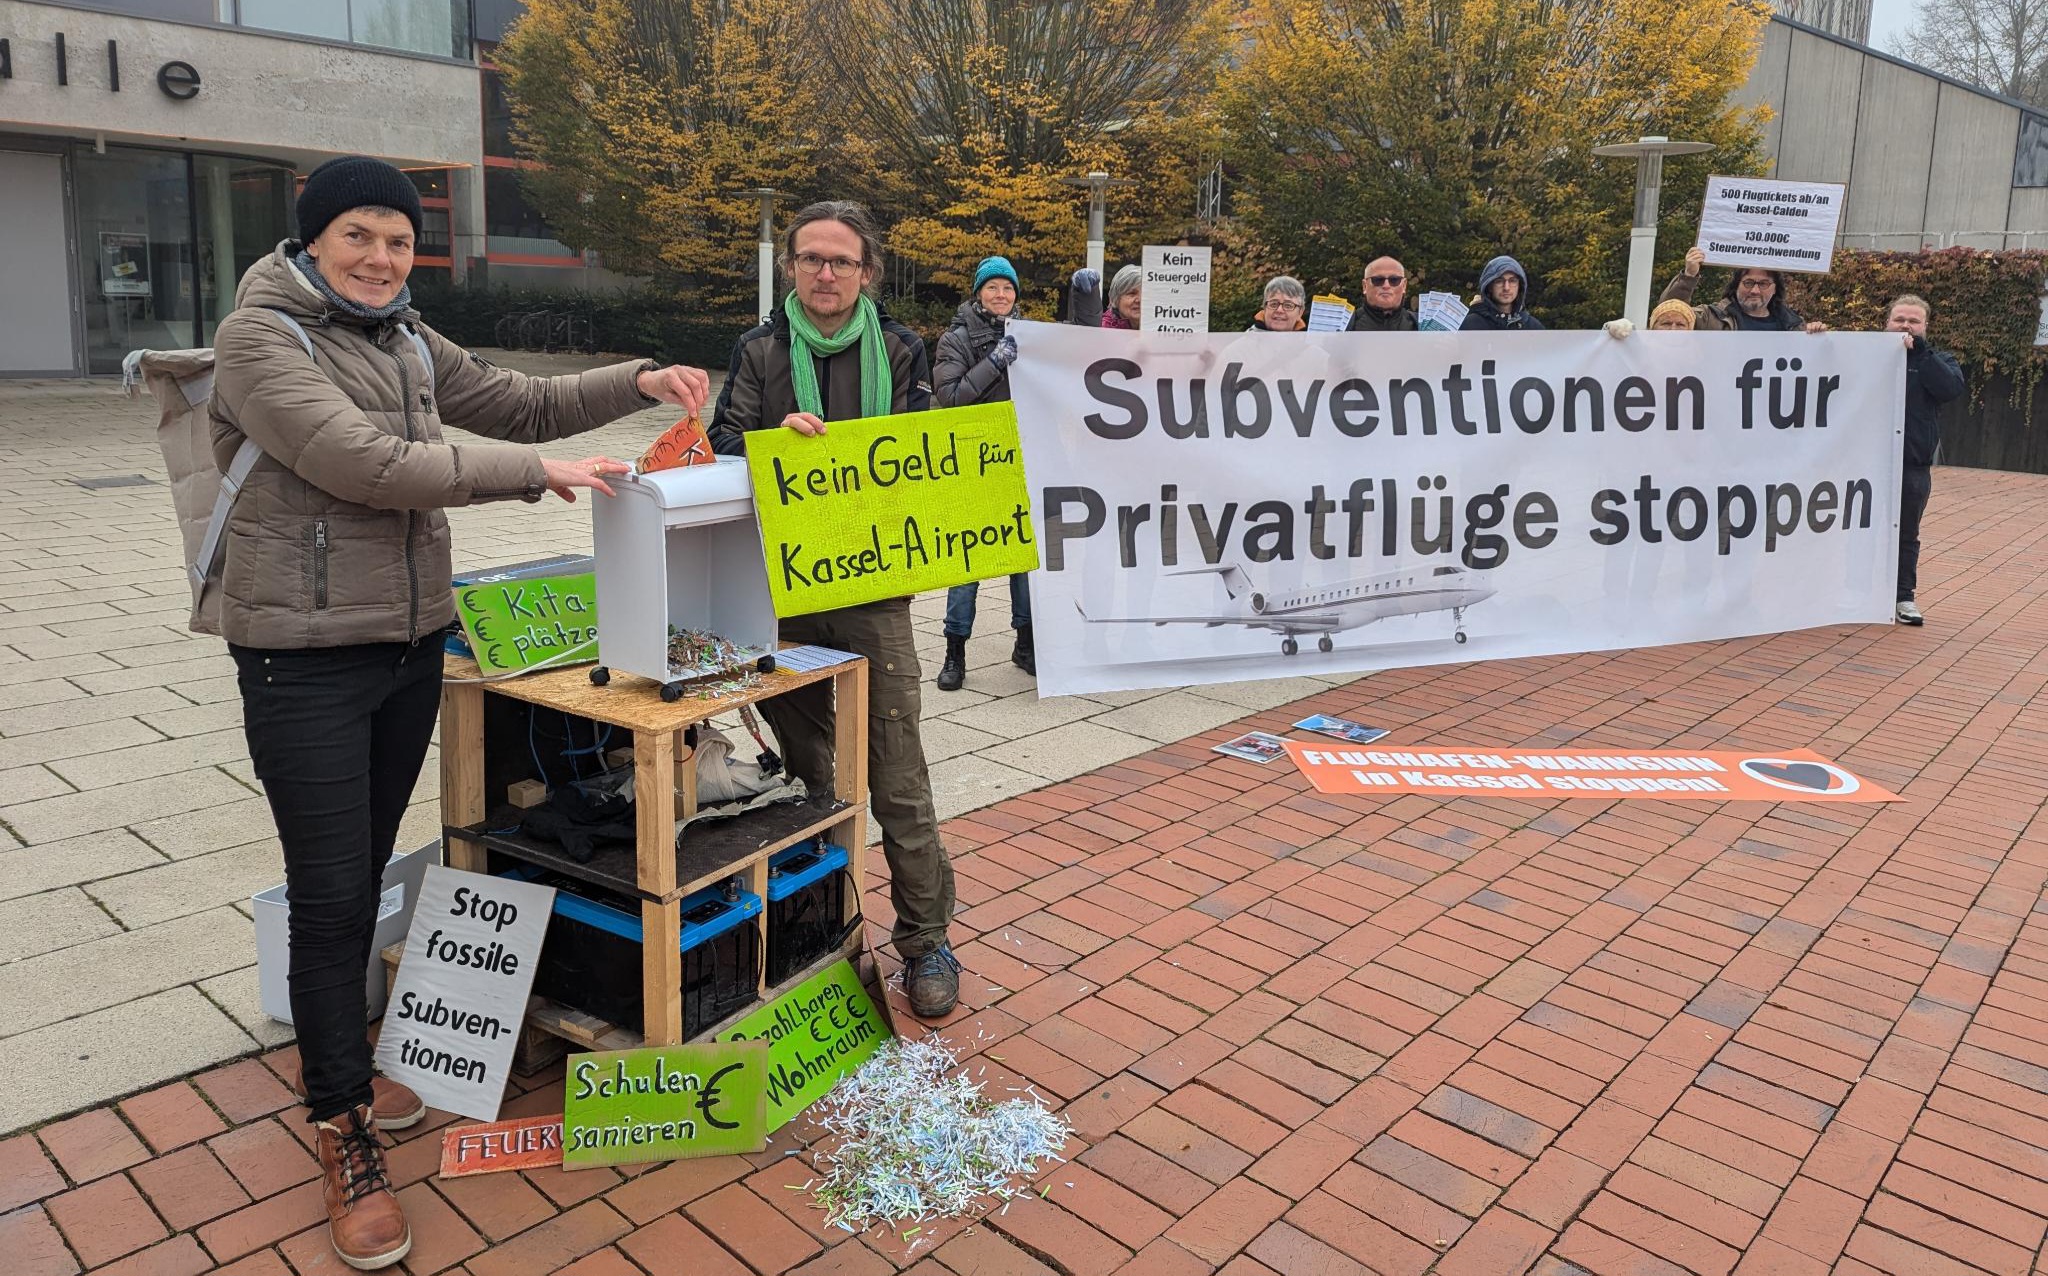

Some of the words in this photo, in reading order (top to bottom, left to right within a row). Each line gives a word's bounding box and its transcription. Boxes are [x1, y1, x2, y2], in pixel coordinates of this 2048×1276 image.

[1721, 189, 1740, 199] 500
[1742, 190, 1796, 203] Flugtickets
[1799, 193, 1829, 205] ab/an
[1736, 203, 1808, 217] Kassel-Calden
[1709, 242, 1821, 260] Steuerverschwendung
[1745, 231, 1790, 243] 130.000€
[1147, 271, 1207, 284] Steuergeld
[1163, 252, 1193, 266] Kein
[1154, 305, 1202, 318] Privat-
[1084, 358, 1705, 439] Subventionen
[1736, 357, 1840, 430] für
[772, 457, 862, 505] kein
[868, 432, 960, 487] Geld
[979, 442, 1017, 476] für
[1043, 475, 1558, 571] Privatflüge
[1589, 475, 1873, 556] stoppen
[780, 504, 1032, 591] Kassel-Airport
[1301, 750, 1728, 772] FLUGHAFEN-WAHNSINN
[1351, 770, 1400, 786] in
[1398, 770, 1545, 790] Kassel
[1543, 775, 1731, 792] stoppen!
[450, 887, 518, 932] Stop
[426, 930, 519, 975] fossile
[397, 991, 512, 1040] Subven-
[400, 1038, 487, 1083] tionen
[575, 1057, 701, 1100] Schulen
[767, 1020, 877, 1107] Wohnraum
[568, 1117, 696, 1152] sanieren
